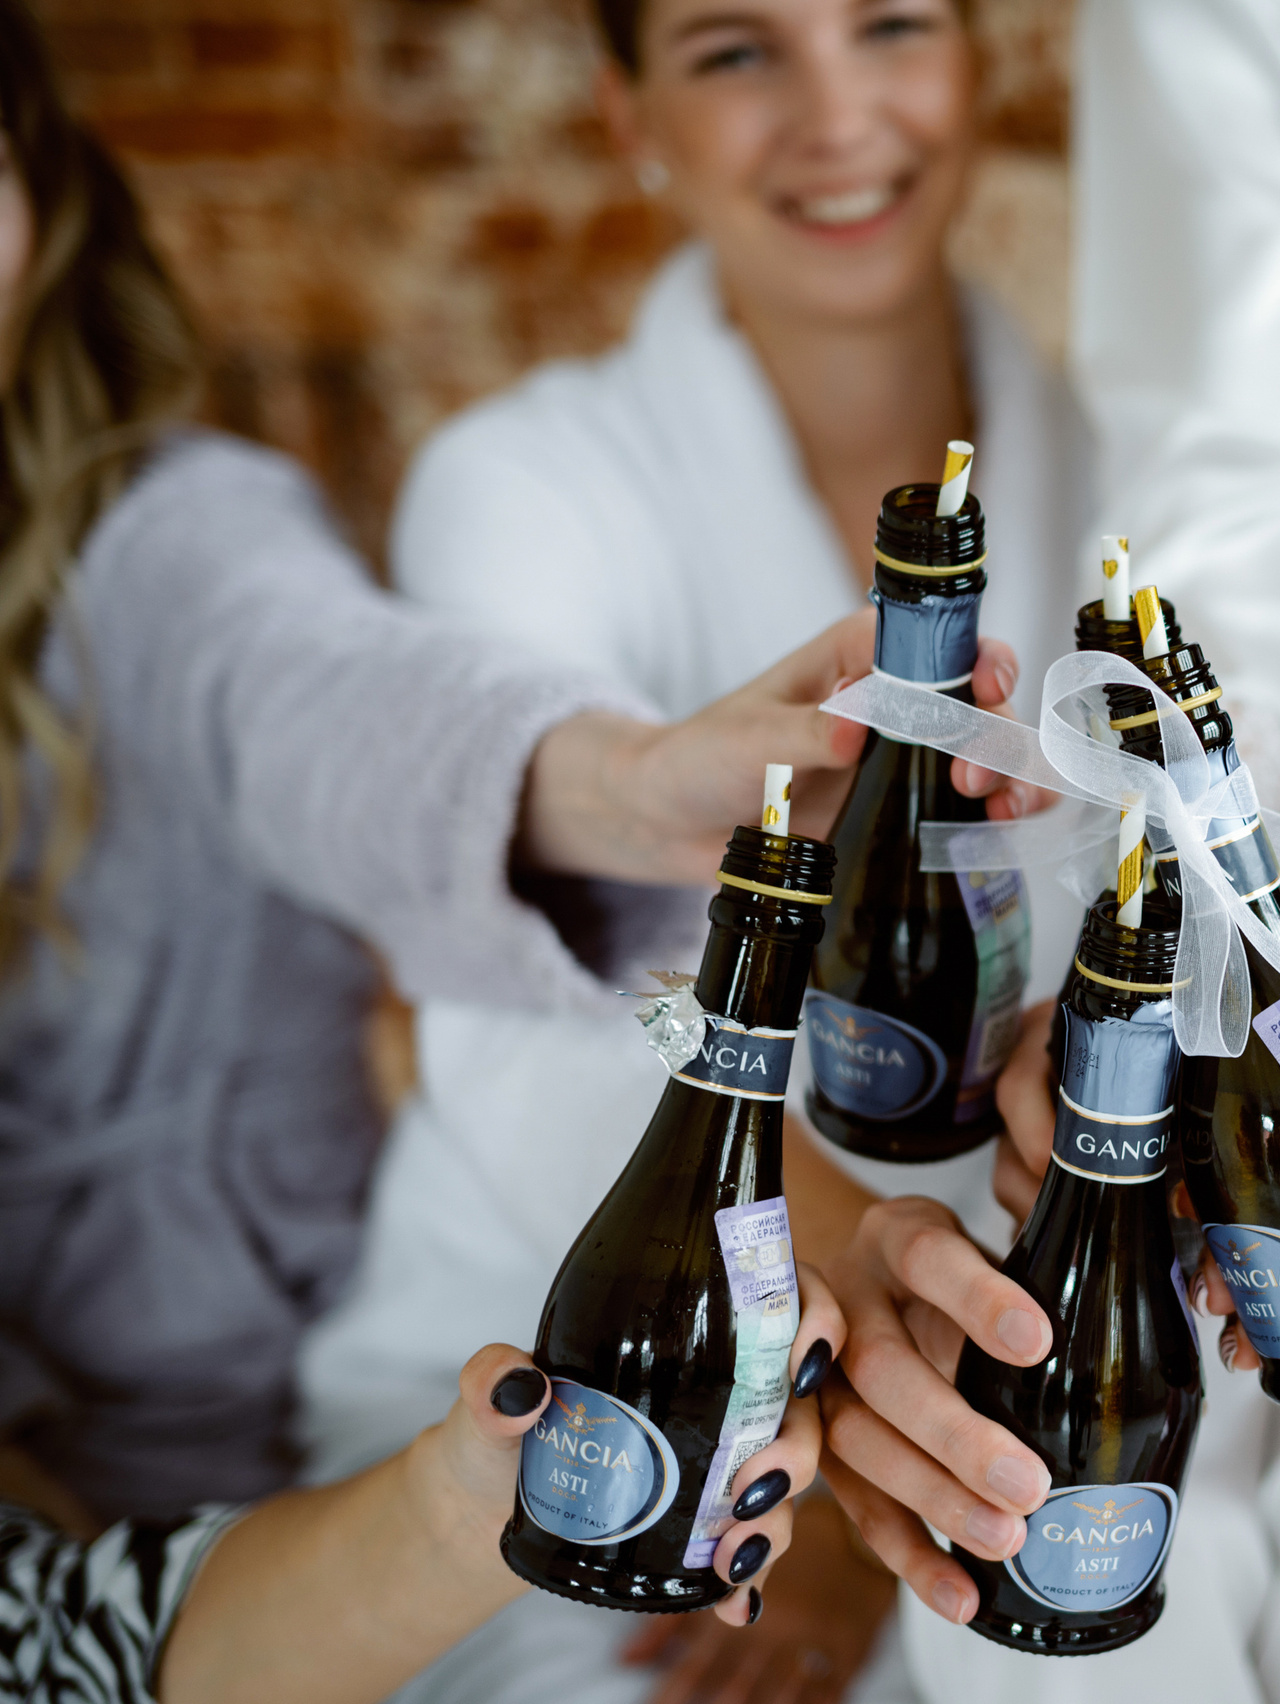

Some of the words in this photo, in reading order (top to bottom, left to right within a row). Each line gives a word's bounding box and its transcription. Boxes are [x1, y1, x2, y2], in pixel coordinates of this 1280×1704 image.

[812, 1018, 906, 1068] GANCIA
[700, 1044, 767, 1075] NCIA
[1245, 1302, 1277, 1318] ASTI
[1270, 1334, 1280, 1343] OF
[534, 1417, 633, 1473] GANCIA
[548, 1467, 589, 1495] ASTI
[528, 1491, 562, 1515] PRODUCT
[564, 1511, 577, 1520] OF
[579, 1516, 608, 1529] ITALY
[1042, 1518, 1154, 1545] GANCIA
[1074, 1556, 1120, 1572] ASTI
[1042, 1585, 1092, 1596] PRODUCT
[1095, 1587, 1108, 1595] OF
[1111, 1582, 1136, 1593] ITALY
